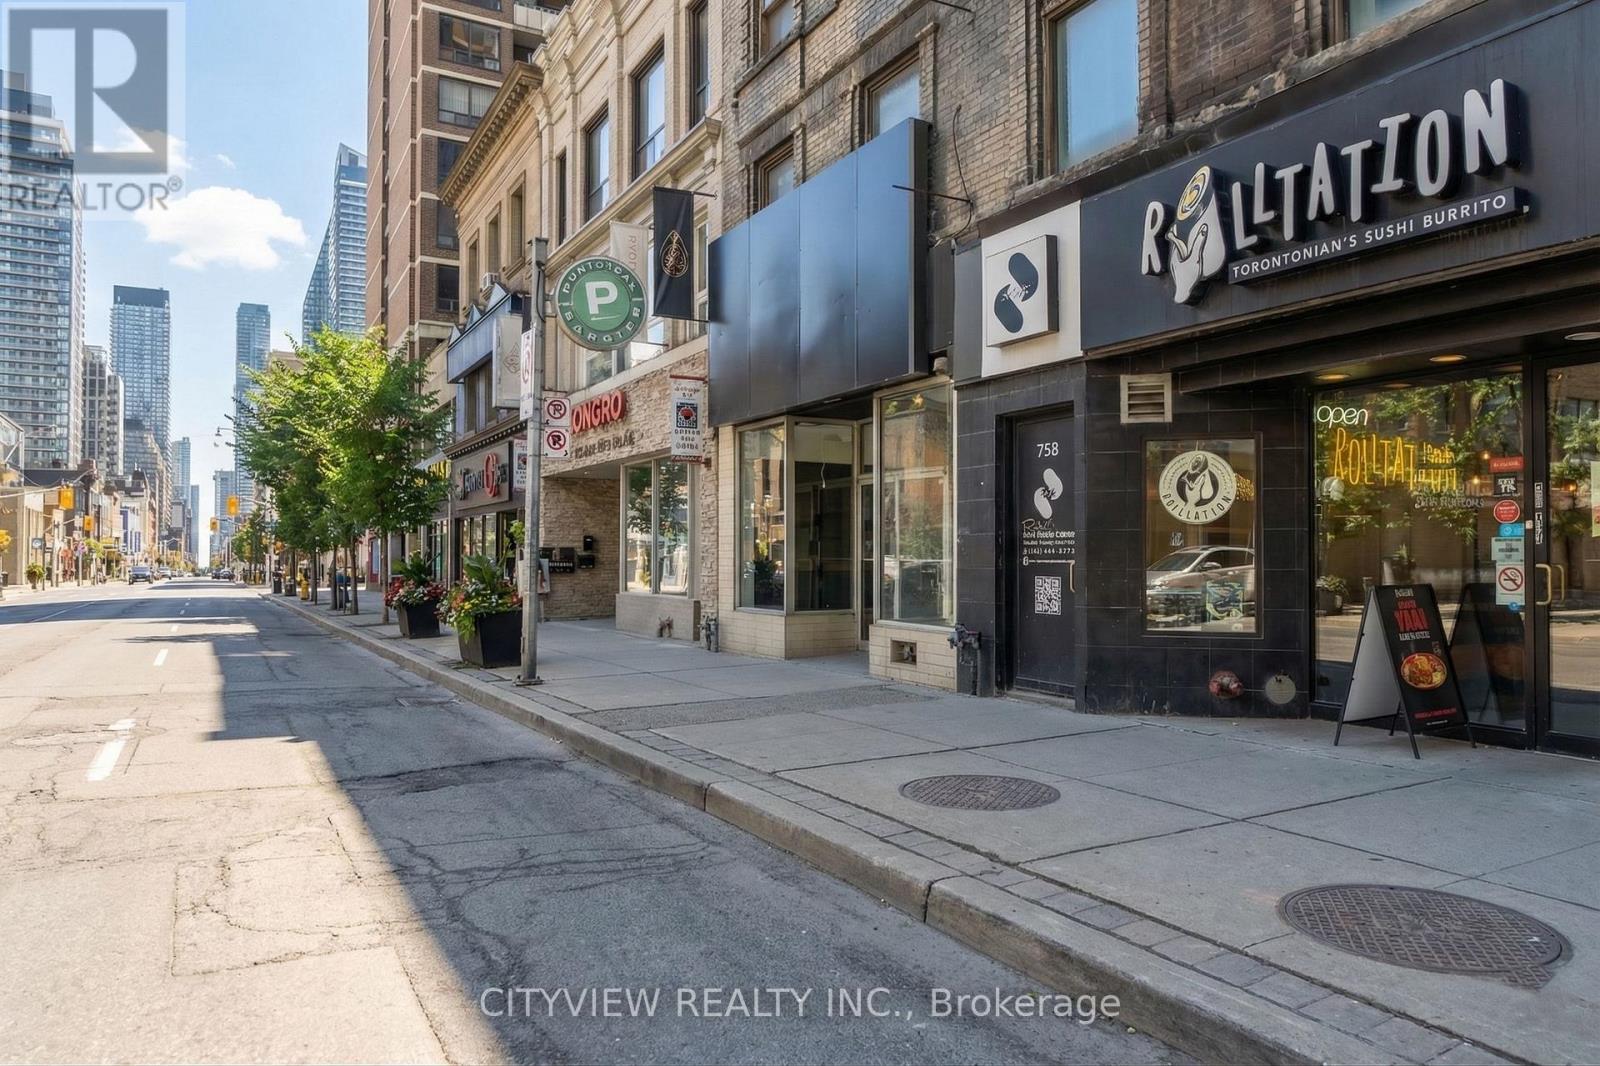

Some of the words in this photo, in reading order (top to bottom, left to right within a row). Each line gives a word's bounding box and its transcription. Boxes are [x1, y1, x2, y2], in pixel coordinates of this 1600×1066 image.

[1233, 234, 1357, 279] TORONTONIAN'S
[1365, 219, 1414, 244] SUSHI
[1423, 195, 1506, 228] BURRITO
[585, 281, 618, 314] P
[571, 390, 625, 434] ONGRO
[1317, 406, 1368, 428] open
[1037, 442, 1059, 458] 758
